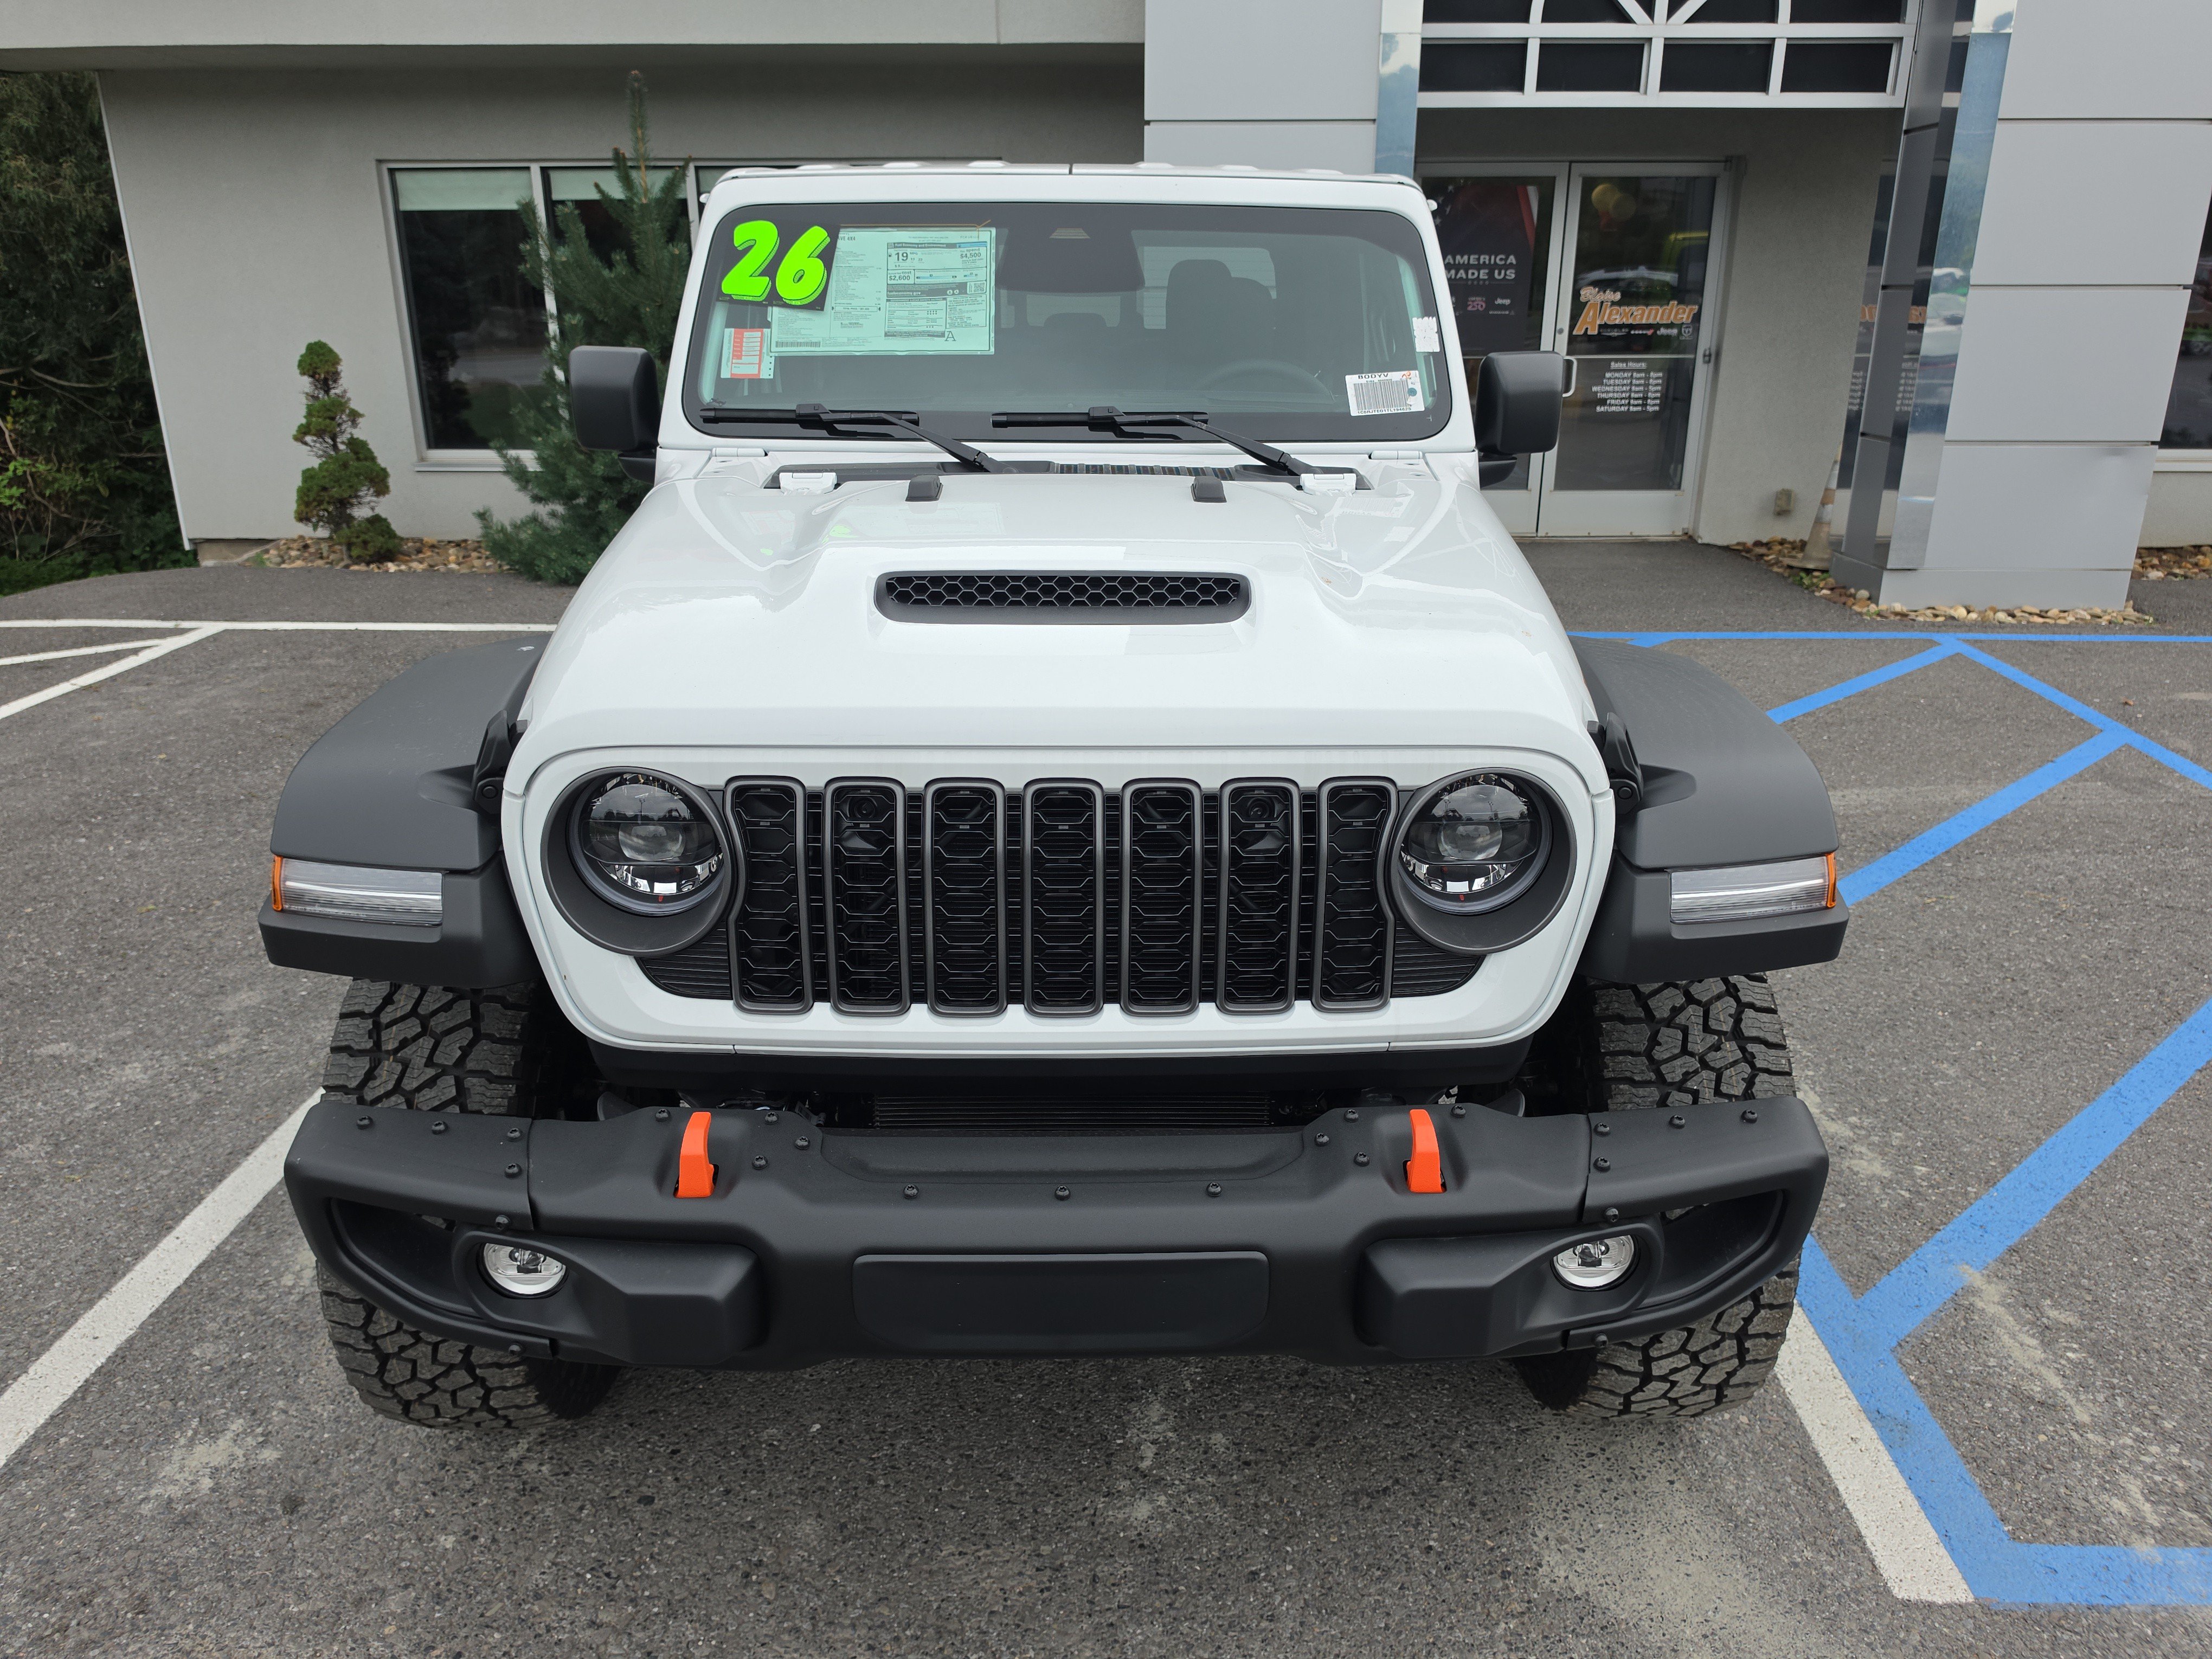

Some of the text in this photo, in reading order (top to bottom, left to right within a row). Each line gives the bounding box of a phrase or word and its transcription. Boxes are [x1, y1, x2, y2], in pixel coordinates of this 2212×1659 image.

[895, 252, 909, 261] 19
[1444, 254, 1516, 265] AMERICA
[722, 220, 833, 305] 26
[1445, 269, 1516, 279] MADE US
[1573, 300, 1699, 335] Alexander
[944, 331, 956, 342] A
[1610, 361, 1626, 369] Sales
